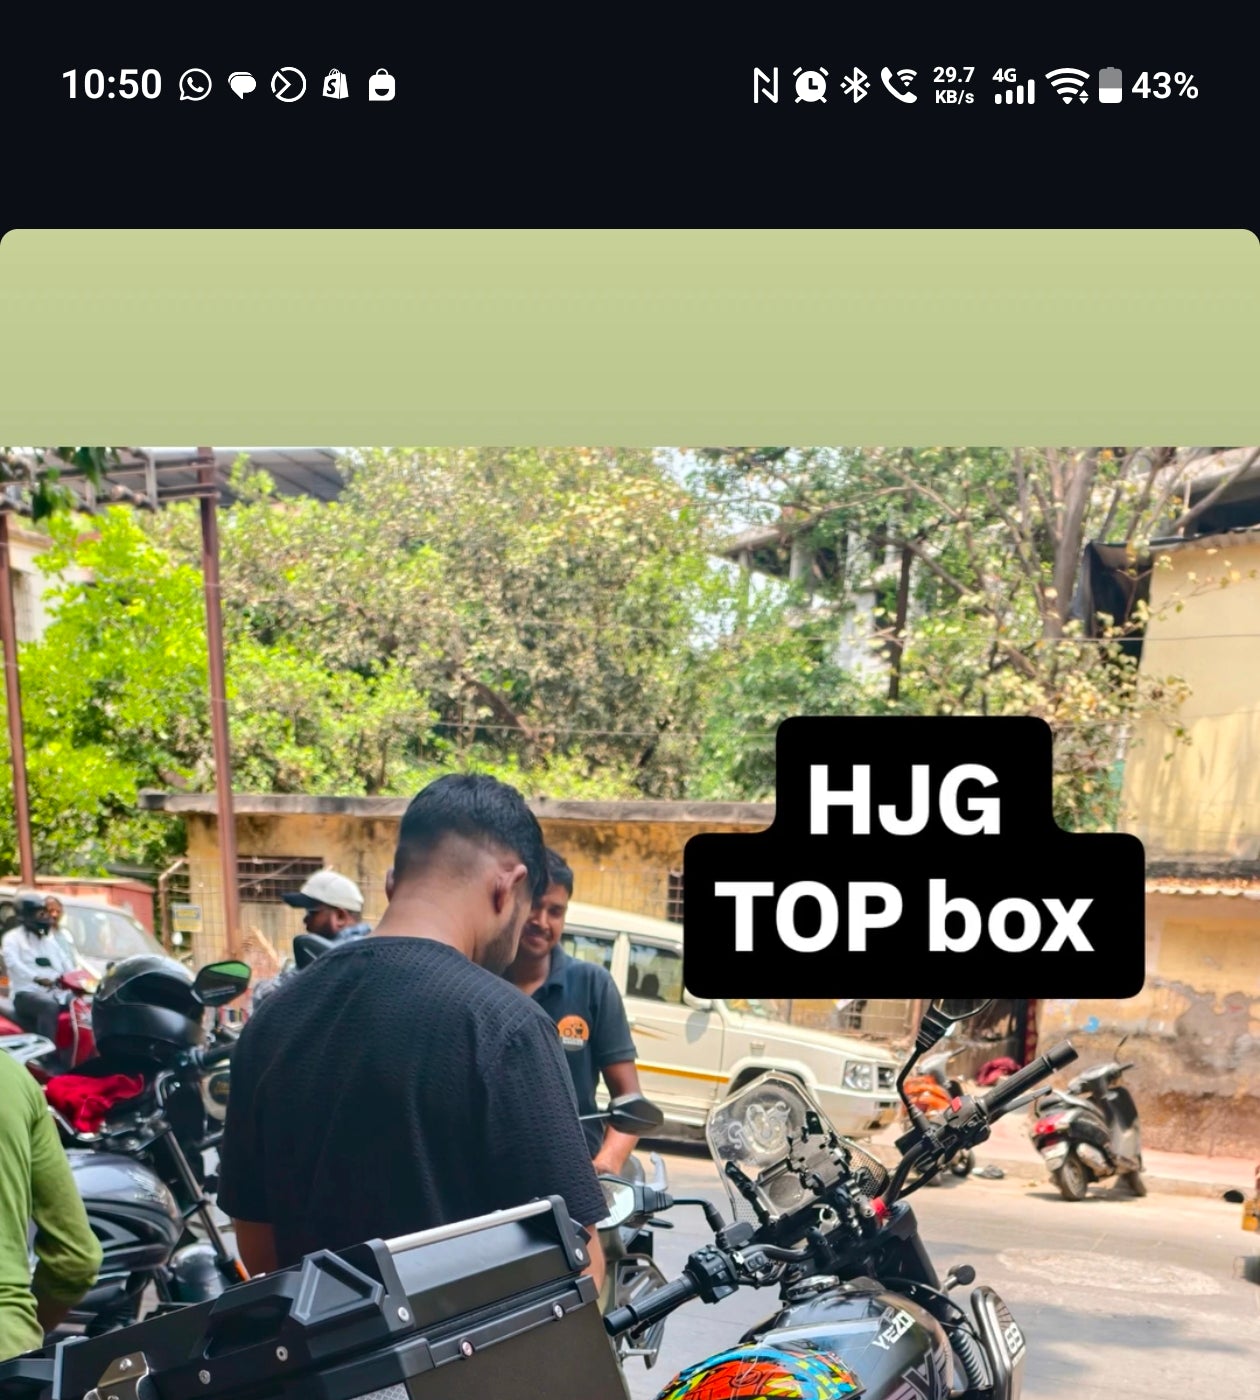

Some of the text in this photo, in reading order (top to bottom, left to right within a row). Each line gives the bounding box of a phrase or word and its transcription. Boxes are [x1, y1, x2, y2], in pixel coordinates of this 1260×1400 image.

[933, 67, 976, 83] 29.7
[992, 68, 1017, 83] 4G
[62, 68, 162, 99] 10:50
[1131, 71, 1199, 99] 43%
[935, 89, 975, 105] KB/s
